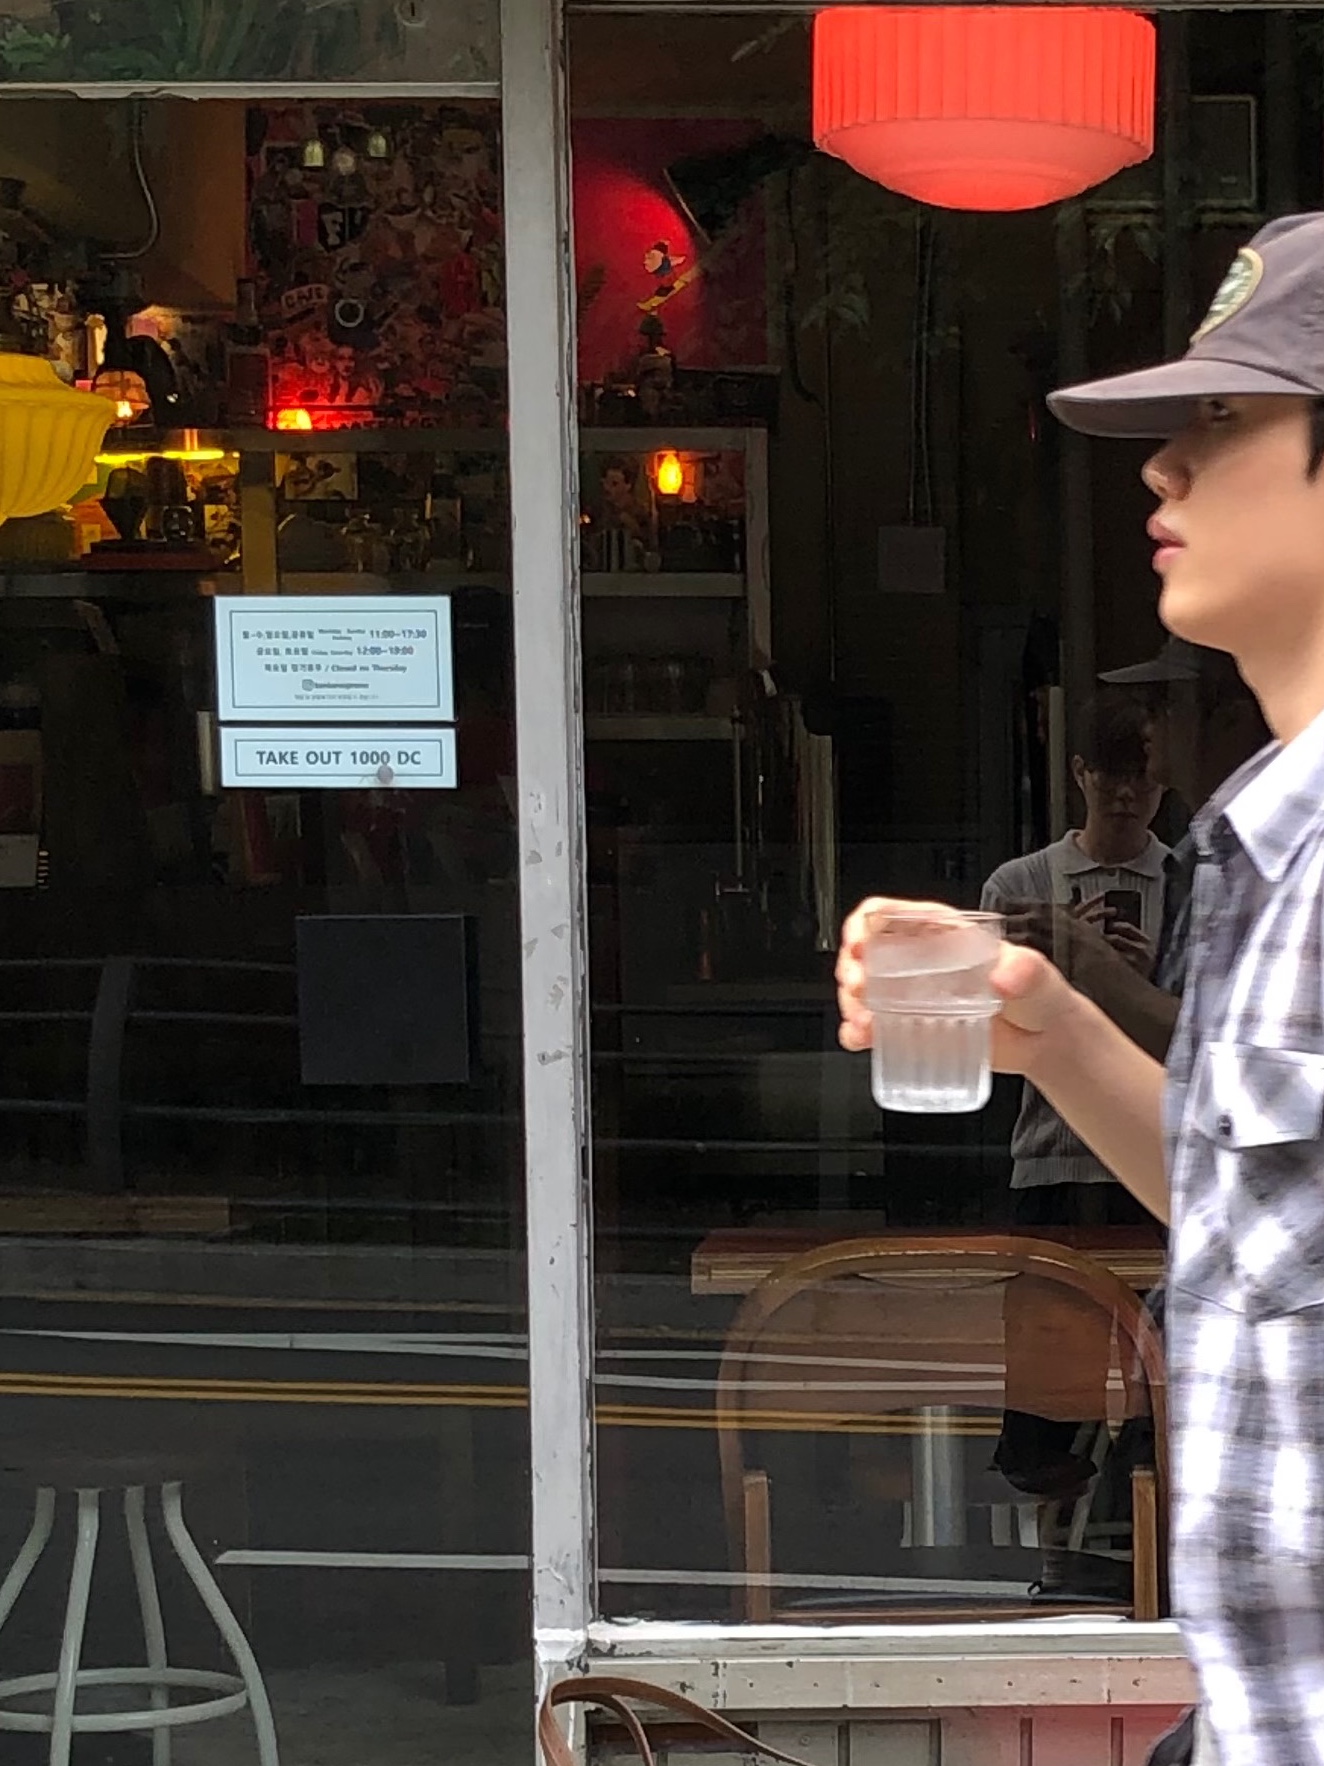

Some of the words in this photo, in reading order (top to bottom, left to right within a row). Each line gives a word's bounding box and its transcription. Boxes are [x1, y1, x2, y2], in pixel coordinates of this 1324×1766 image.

[256, 750, 299, 765] TAKE
[306, 750, 343, 765] OUT
[350, 750, 391, 765] 1000
[397, 750, 421, 765] DC
